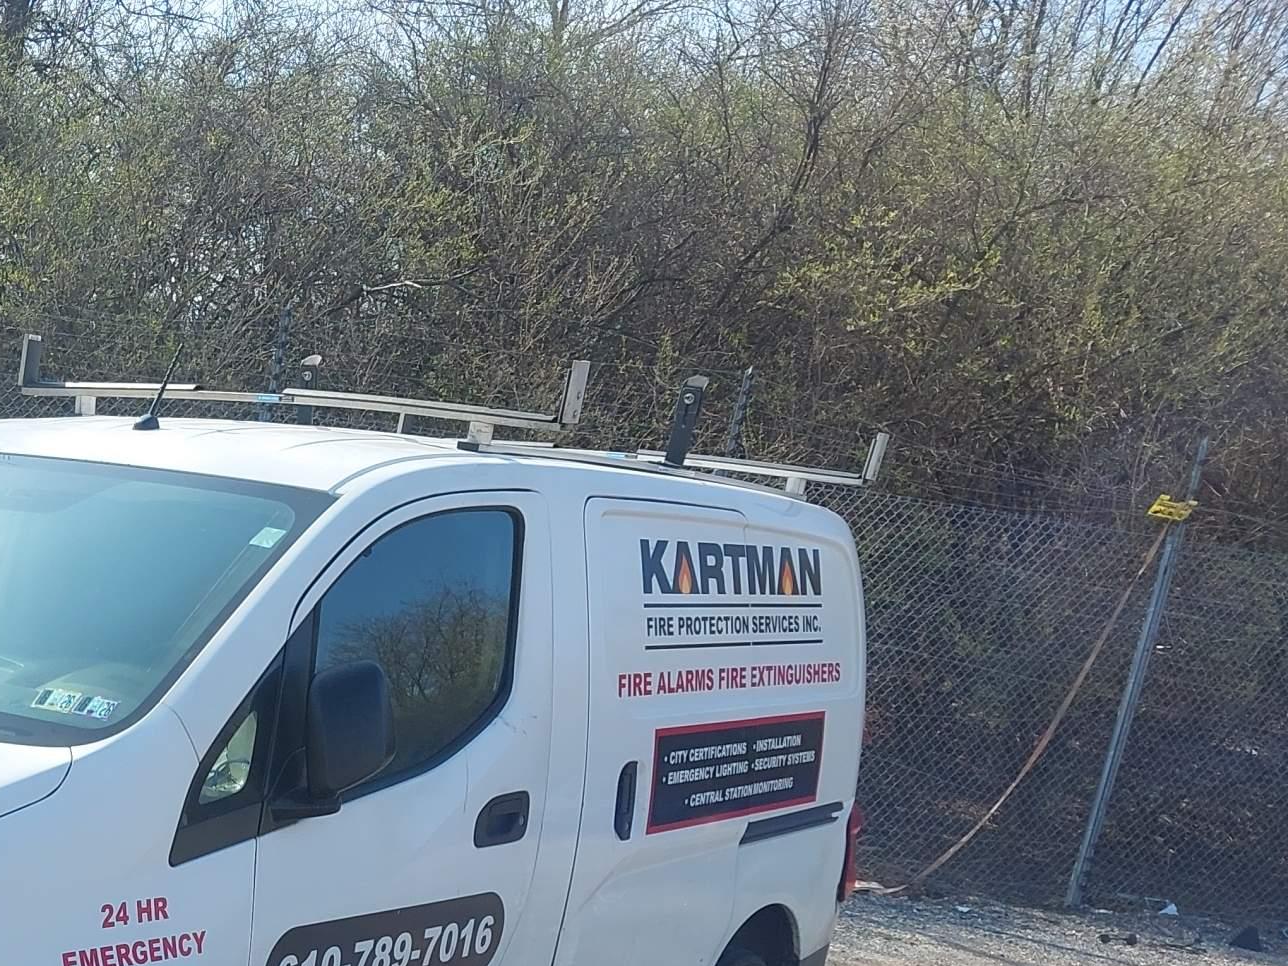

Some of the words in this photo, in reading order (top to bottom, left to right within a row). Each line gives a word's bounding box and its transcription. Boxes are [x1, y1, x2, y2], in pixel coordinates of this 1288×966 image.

[640, 539, 822, 595] KARTMAN
[647, 617, 674, 637] FIRE
[678, 615, 749, 636] PROTECTION
[752, 615, 800, 633] SERVICES
[802, 615, 822, 633] INC.
[618, 672, 652, 698] FIRE
[657, 668, 714, 694] ALARMS
[718, 667, 747, 690] FIRE
[751, 662, 841, 688] EXTINGUISHERS
[670, 750, 689, 765] CITY
[689, 742, 748, 762] CERTIFICATIONS
[756, 734, 802, 753] INSTALLATION
[755, 754, 787, 771] SECURITY
[787, 750, 815, 765] SYSTEMS
[667, 766, 715, 785] EMERGENCY
[716, 761, 749, 778] LIGHTING
[690, 790, 724, 807] CENTRAL
[101, 902, 129, 928] 24
[136, 897, 169, 923] HR
